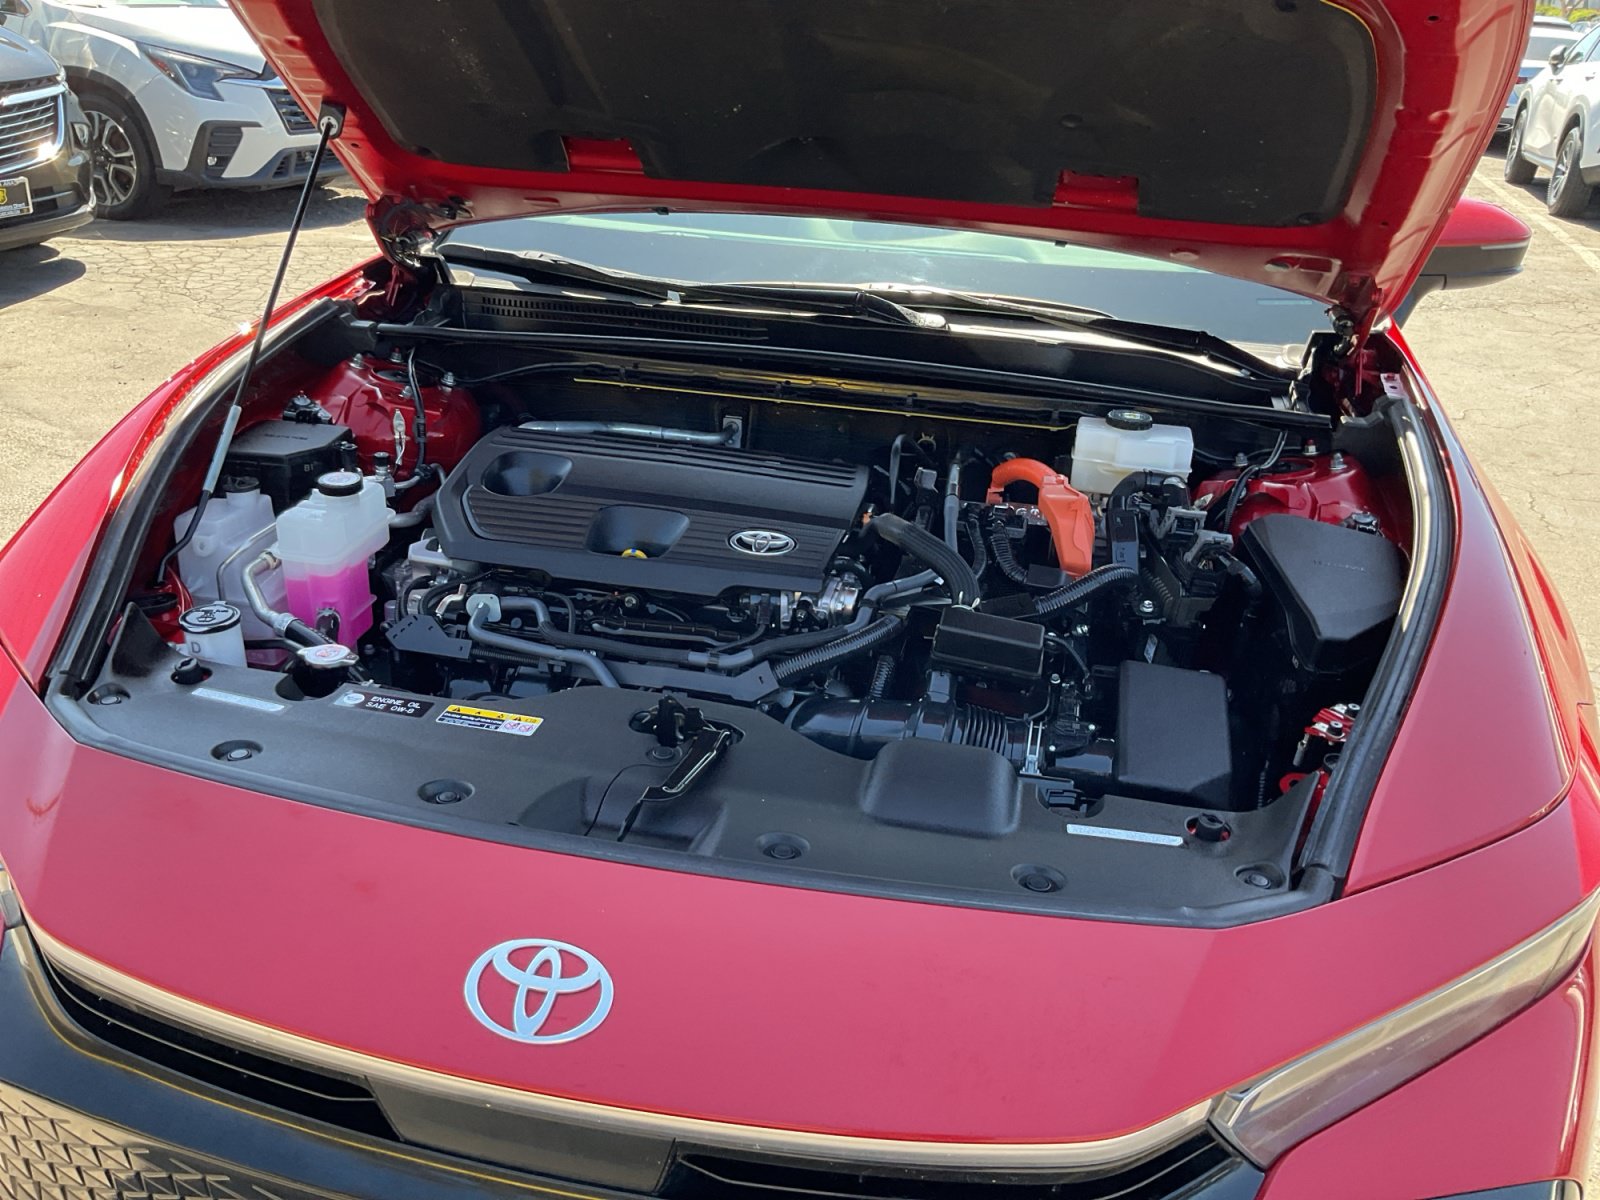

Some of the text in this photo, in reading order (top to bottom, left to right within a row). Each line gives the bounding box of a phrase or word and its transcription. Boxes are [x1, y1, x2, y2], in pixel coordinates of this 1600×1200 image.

[190, 641, 202, 654] D
[365, 701, 387, 710] SAE
[370, 695, 405, 706] ENGINE
[407, 701, 421, 709] OIL
